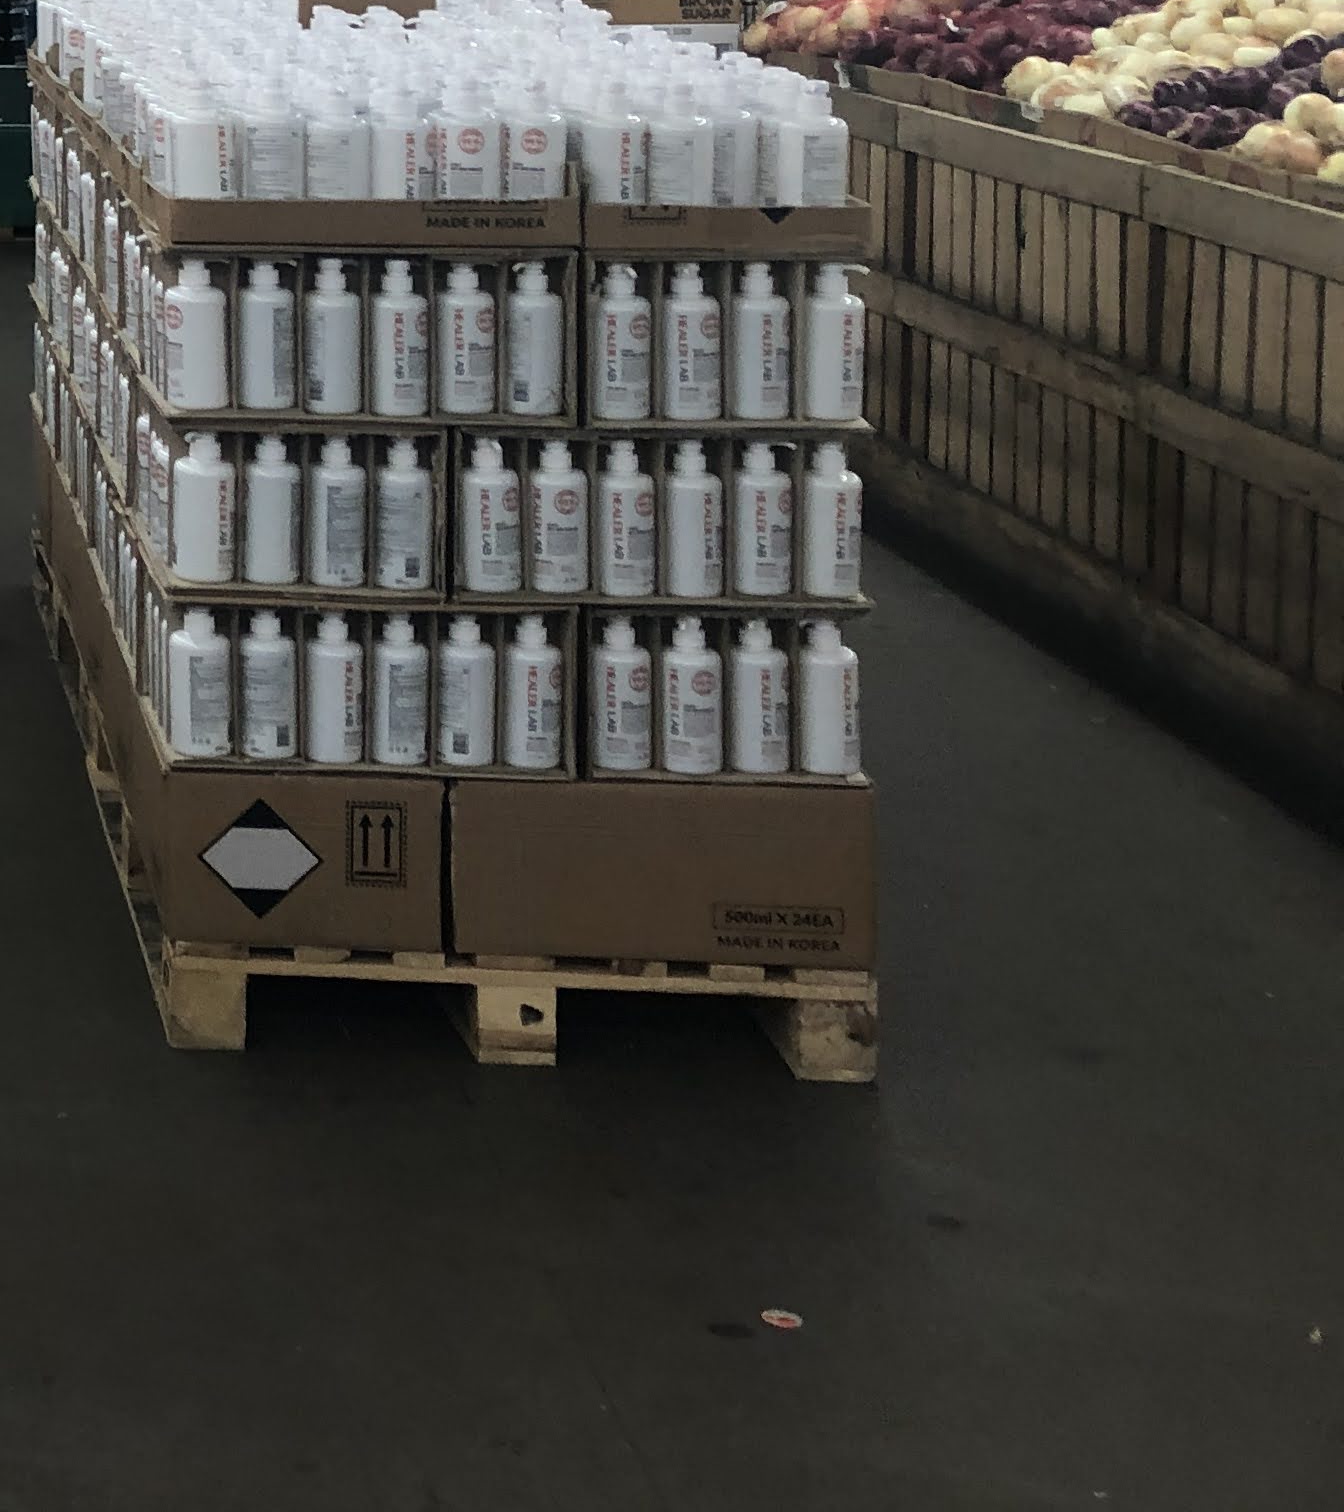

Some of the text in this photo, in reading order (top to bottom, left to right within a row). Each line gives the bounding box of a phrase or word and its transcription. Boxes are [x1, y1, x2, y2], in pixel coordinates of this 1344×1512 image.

[426, 216, 545, 228] MADE IN KOREA
[717, 936, 840, 952] MADE IN KOREA
